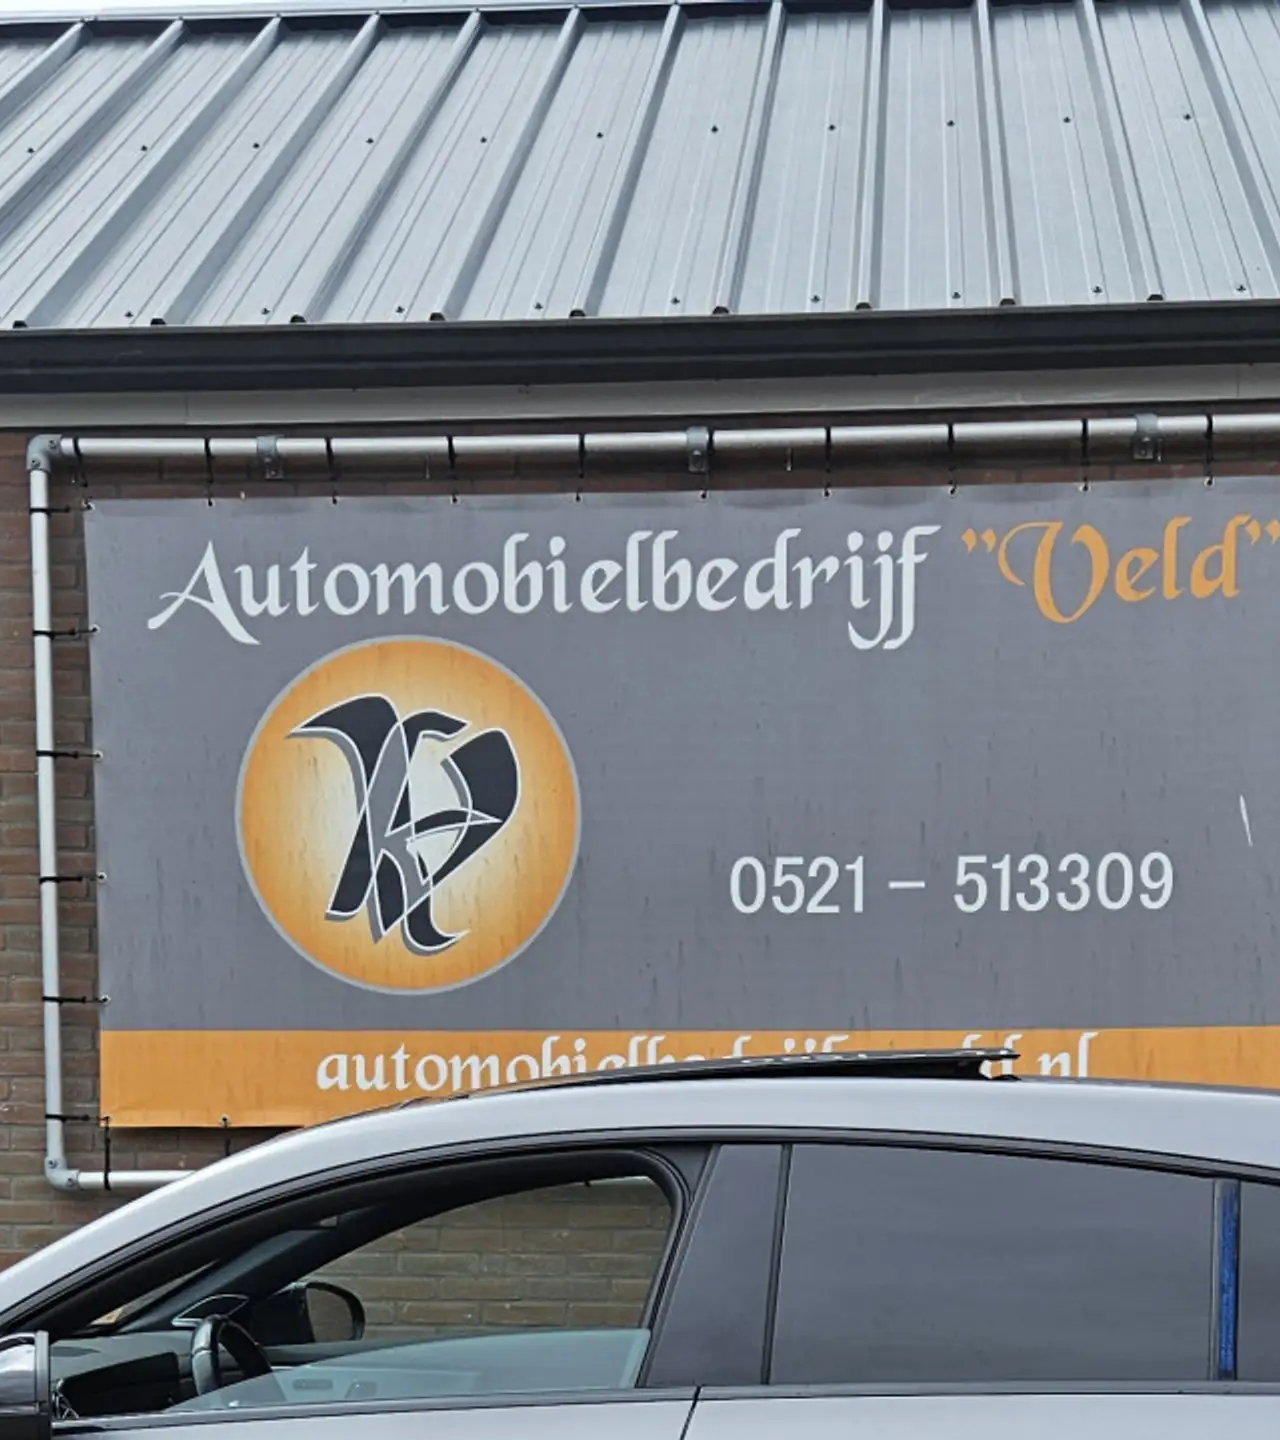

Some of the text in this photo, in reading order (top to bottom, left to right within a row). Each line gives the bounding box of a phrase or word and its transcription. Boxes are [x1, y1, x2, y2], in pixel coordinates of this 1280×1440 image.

[147, 525, 942, 650] Automobielbedrijf
[729, 855, 864, 914] 0521
[953, 851, 1175, 912] 513309
